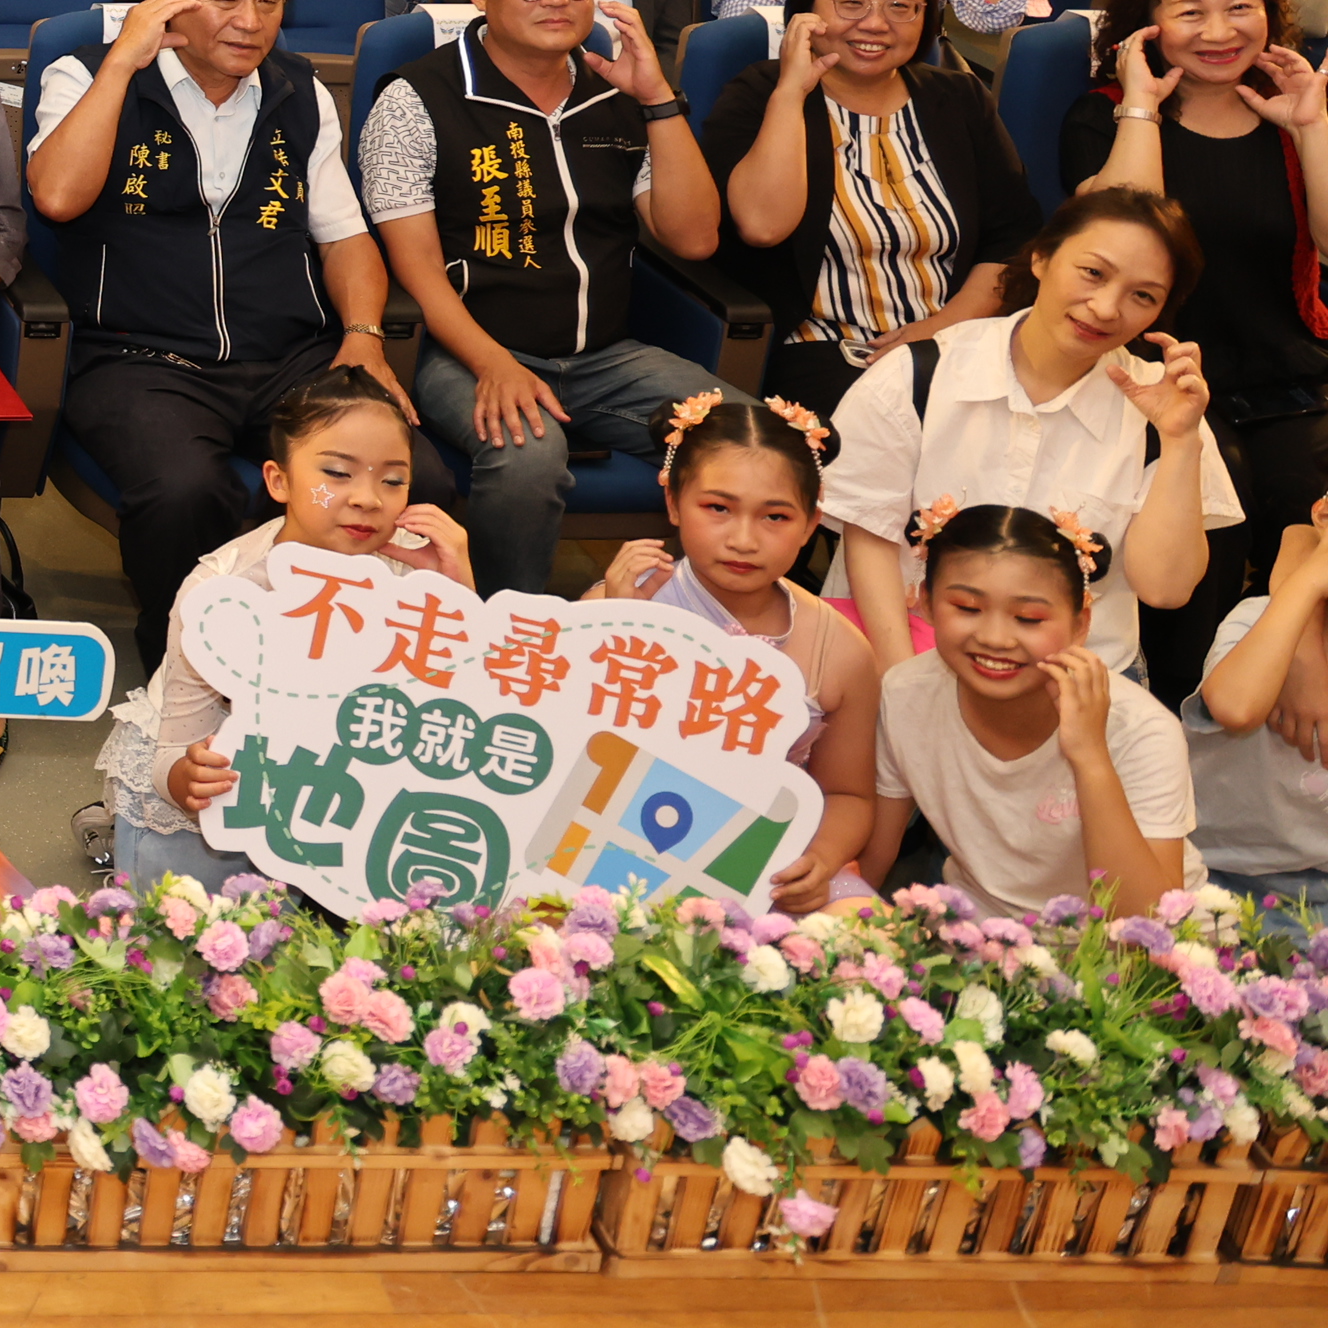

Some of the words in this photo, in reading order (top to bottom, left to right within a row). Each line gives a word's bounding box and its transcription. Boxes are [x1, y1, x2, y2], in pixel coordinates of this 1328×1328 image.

[470, 144, 513, 260] 張至順
[505, 121, 543, 270] 南投縣議員參選人
[281, 565, 785, 756] 不走尋常路
[349, 694, 540, 789] 我就是
[222, 734, 512, 913] 地圖
